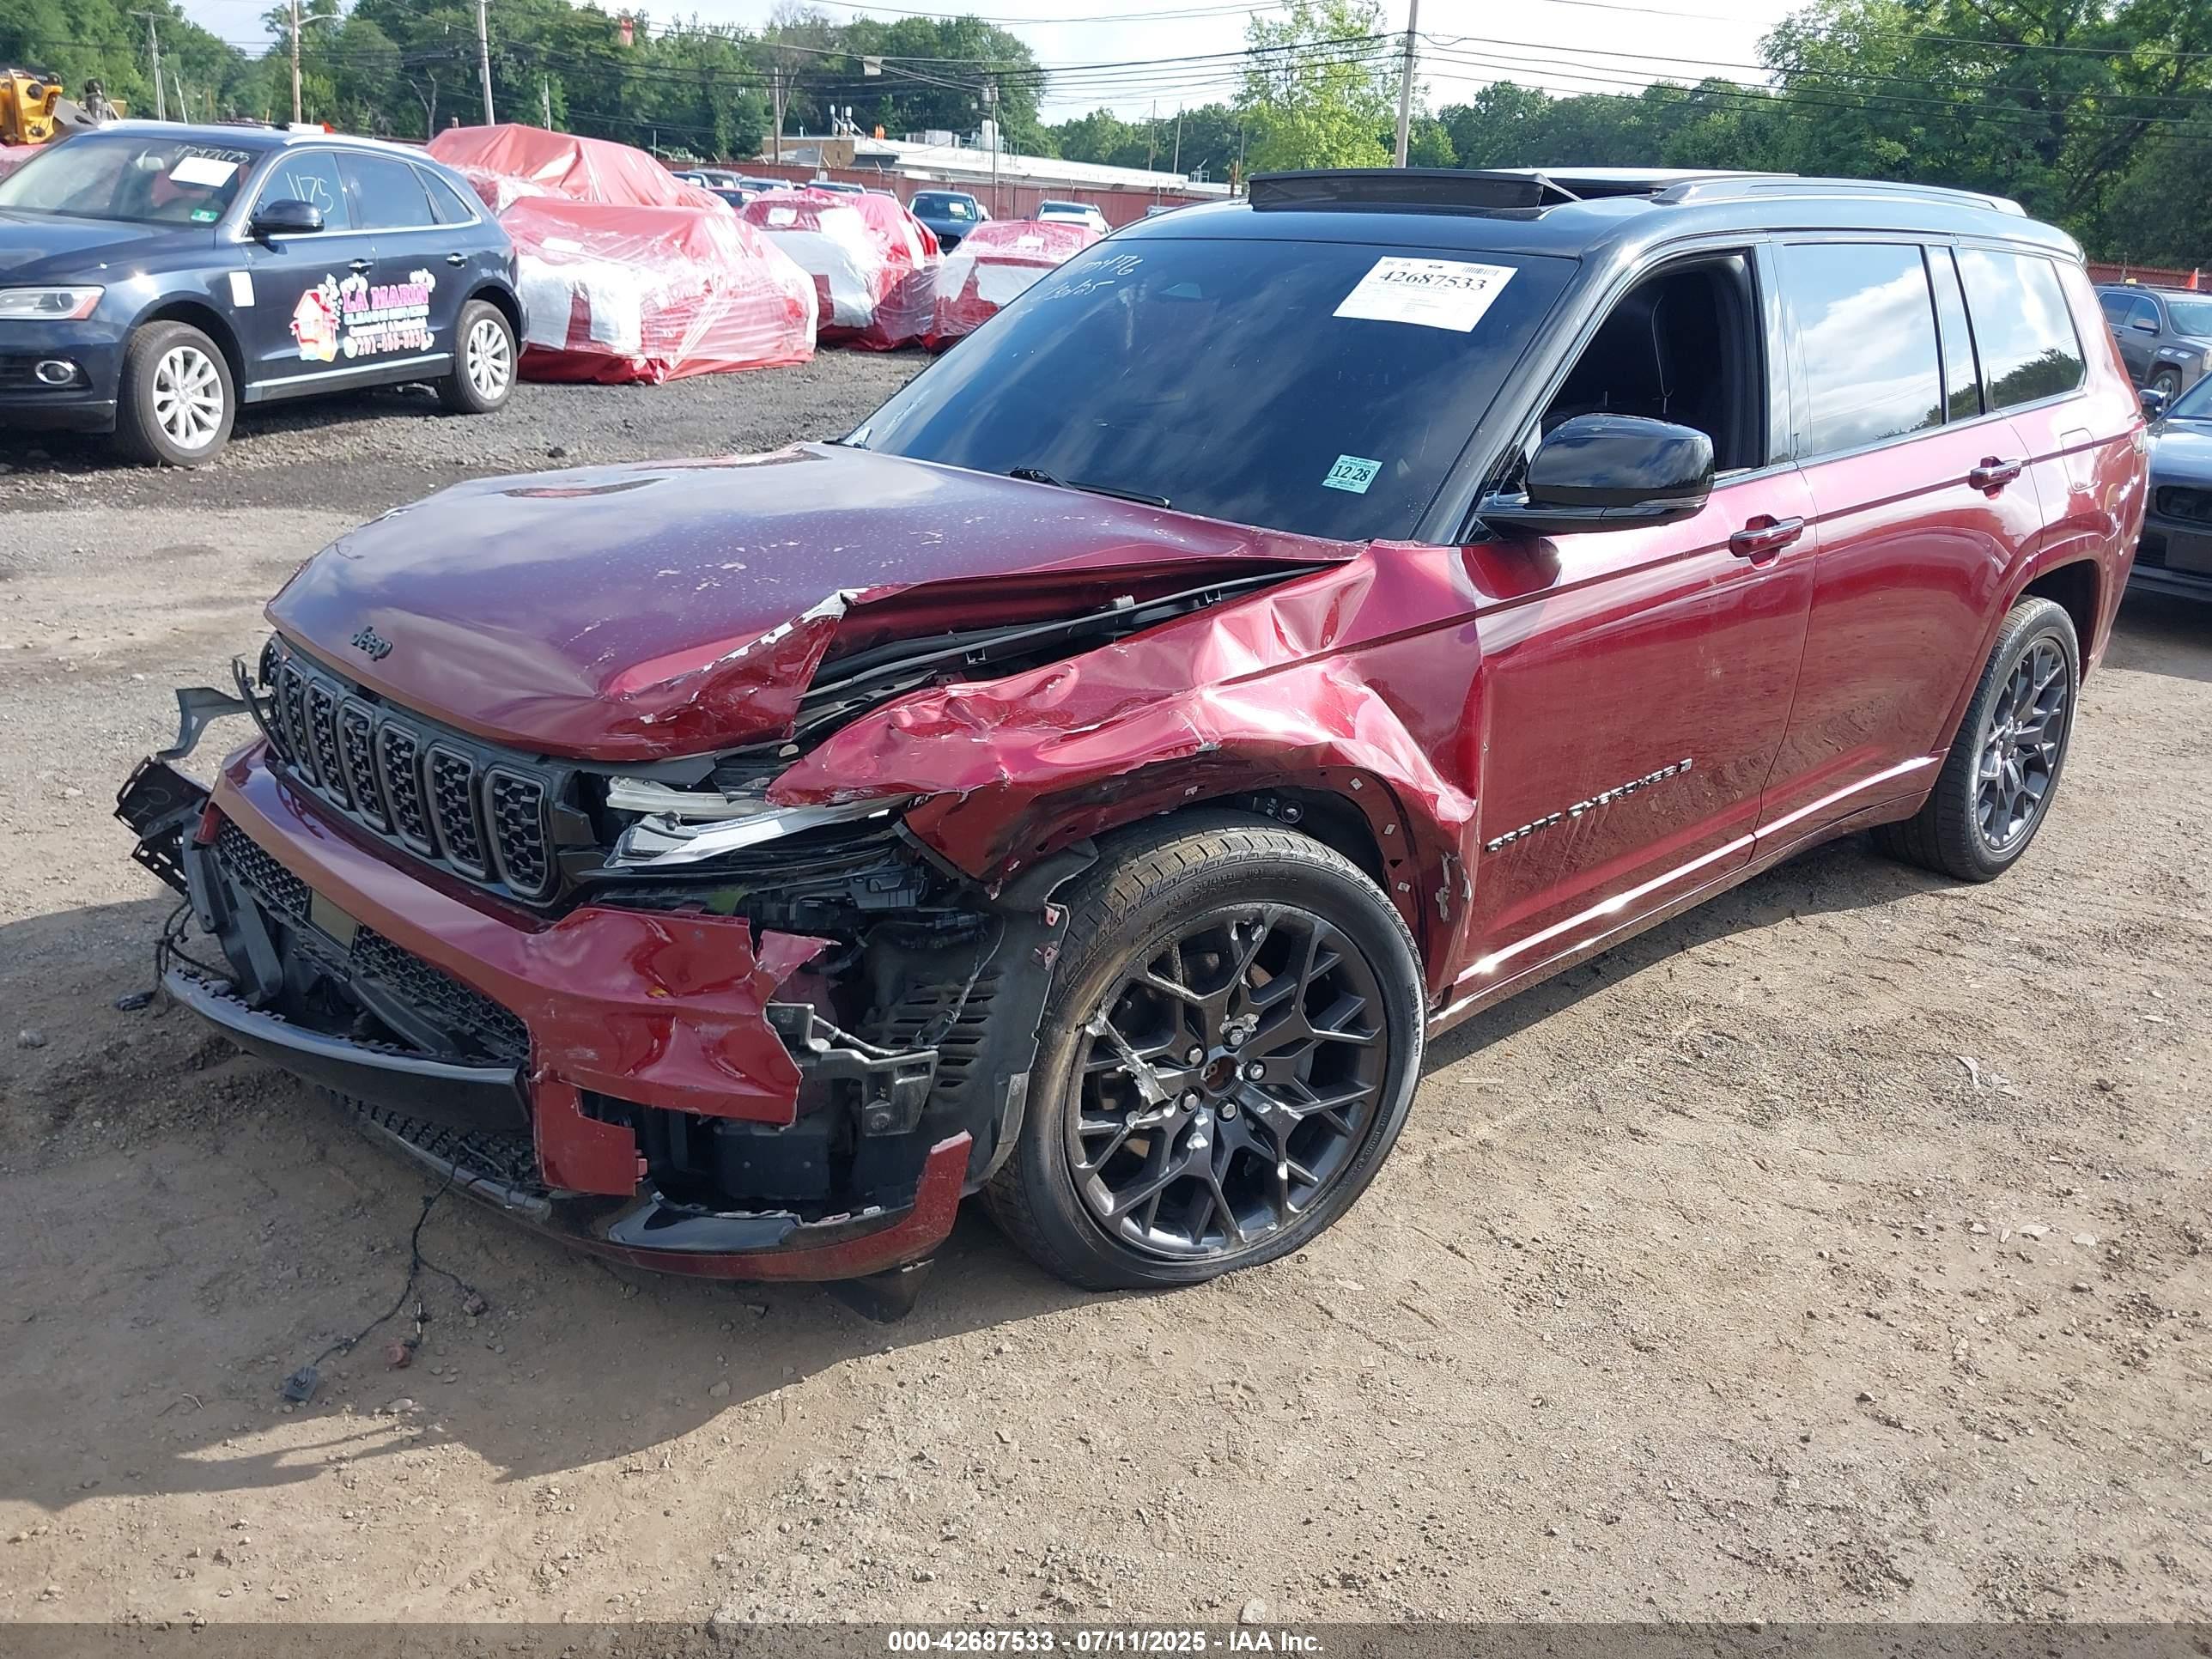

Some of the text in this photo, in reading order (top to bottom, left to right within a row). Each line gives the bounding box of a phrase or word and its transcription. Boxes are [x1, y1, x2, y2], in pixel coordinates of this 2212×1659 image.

[286, 171, 334, 214] 1175
[1378, 270, 1488, 291] 42687533
[343, 289, 369, 313] LA
[370, 283, 429, 310] MARIN
[1333, 465, 1371, 482] 12 28
[350, 625, 392, 662] Jeep
[1566, 764, 1677, 817] CHEROKEE
